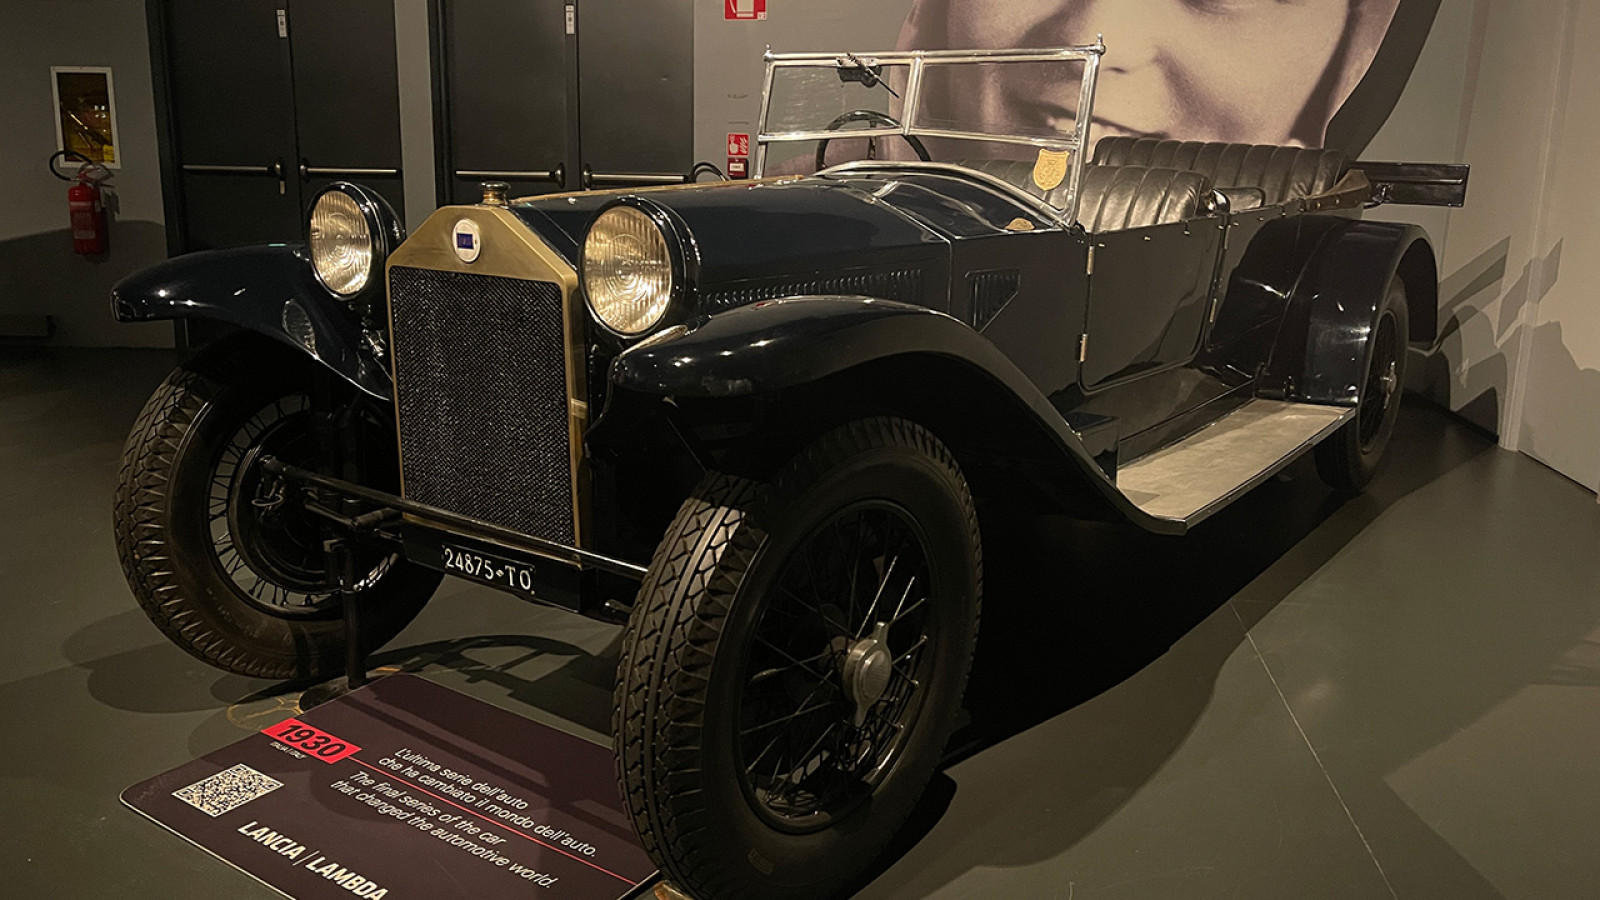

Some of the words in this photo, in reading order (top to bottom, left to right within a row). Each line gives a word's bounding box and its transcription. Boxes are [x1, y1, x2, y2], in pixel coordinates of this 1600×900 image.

[277, 725, 346, 756] 1930
[394, 748, 441, 772] L'ultima
[439, 768, 473, 786] serie
[471, 782, 528, 809] dell'auto
[330, 780, 361, 796] that
[355, 793, 416, 820] changed
[407, 816, 434, 831] the
[430, 828, 510, 866] automotive
[508, 863, 558, 889] world.
[349, 771, 375, 786] The
[372, 782, 407, 799] final
[398, 795, 441, 817] series
[438, 813, 463, 824] of
[454, 820, 481, 835] the
[478, 832, 507, 845] car
[378, 758, 403, 771] che
[400, 765, 420, 778] ha
[418, 775, 476, 803] cambiato
[474, 797, 490, 808] il
[484, 804, 535, 829] mondo
[533, 825, 596, 857] dell'auto.
[237, 820, 306, 860] LANCIA
[305, 856, 388, 900] LAMBDA
